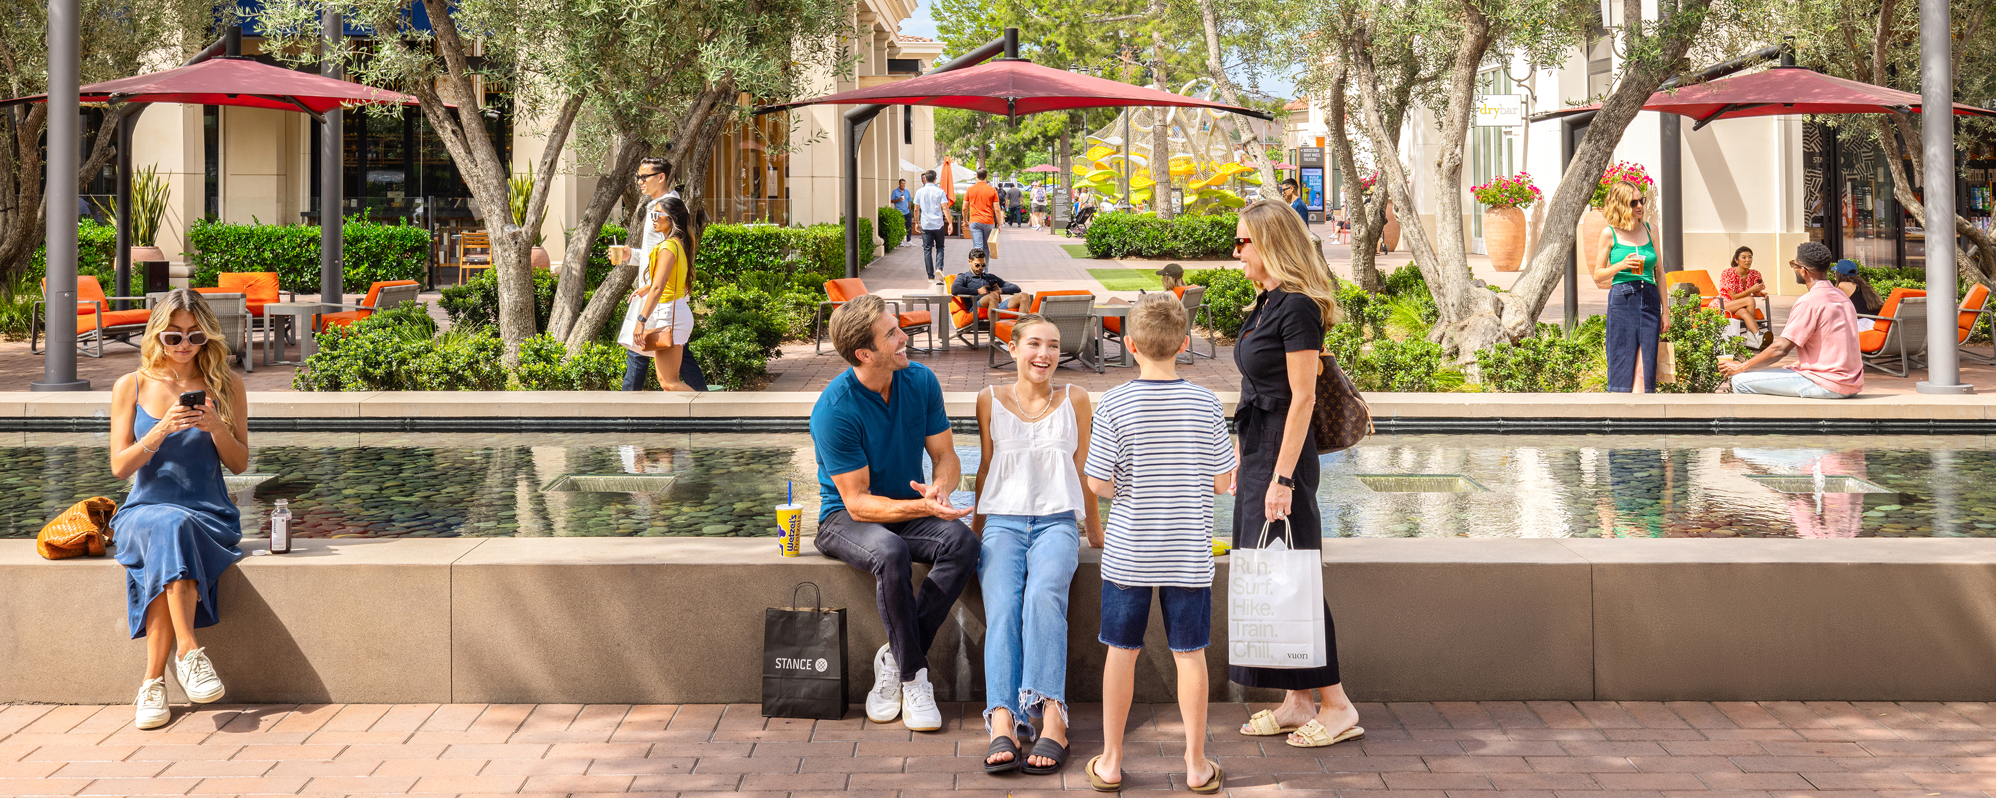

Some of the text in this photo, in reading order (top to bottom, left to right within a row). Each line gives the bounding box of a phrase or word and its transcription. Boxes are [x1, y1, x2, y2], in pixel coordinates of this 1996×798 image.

[1479, 103, 1519, 119] drybar
[786, 514, 797, 552] Wetzel's
[1233, 556, 1272, 574] Run.
[1232, 577, 1274, 595] Surf.
[1232, 598, 1274, 616] Hike.
[1232, 620, 1278, 638] Train.
[1232, 641, 1274, 658] Chill.
[775, 658, 812, 670] STANCE
